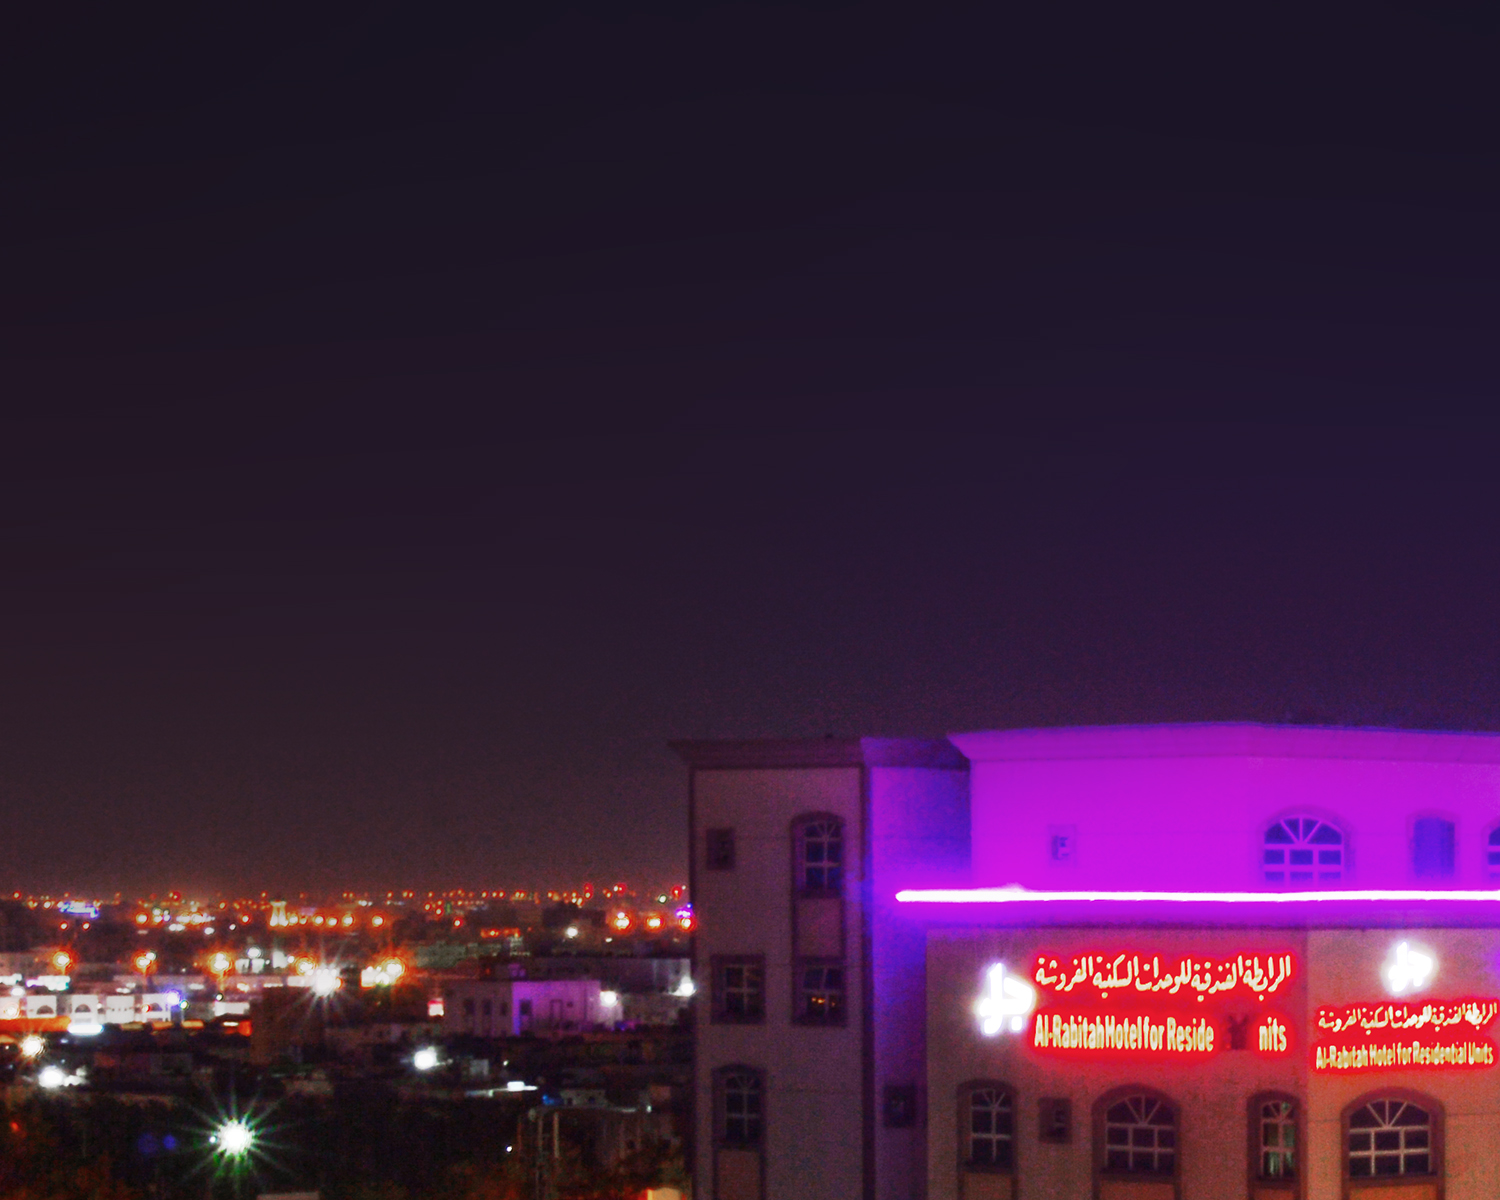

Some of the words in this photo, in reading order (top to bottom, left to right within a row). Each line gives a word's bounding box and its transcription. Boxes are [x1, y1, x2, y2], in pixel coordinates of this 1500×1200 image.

[1243, 955, 1291, 1001] الرابطة
[1034, 1013, 1104, 1050] Al-Rabitah
[1104, 1014, 1142, 1050] Hotel
[1143, 1014, 1165, 1051] for
[1315, 1044, 1368, 1070] Al-Rabitah
[1369, 1043, 1396, 1067] Hotel
[1396, 1041, 1412, 1066] for
[1412, 1041, 1467, 1066] Residential
[1468, 1041, 1494, 1065] Units
